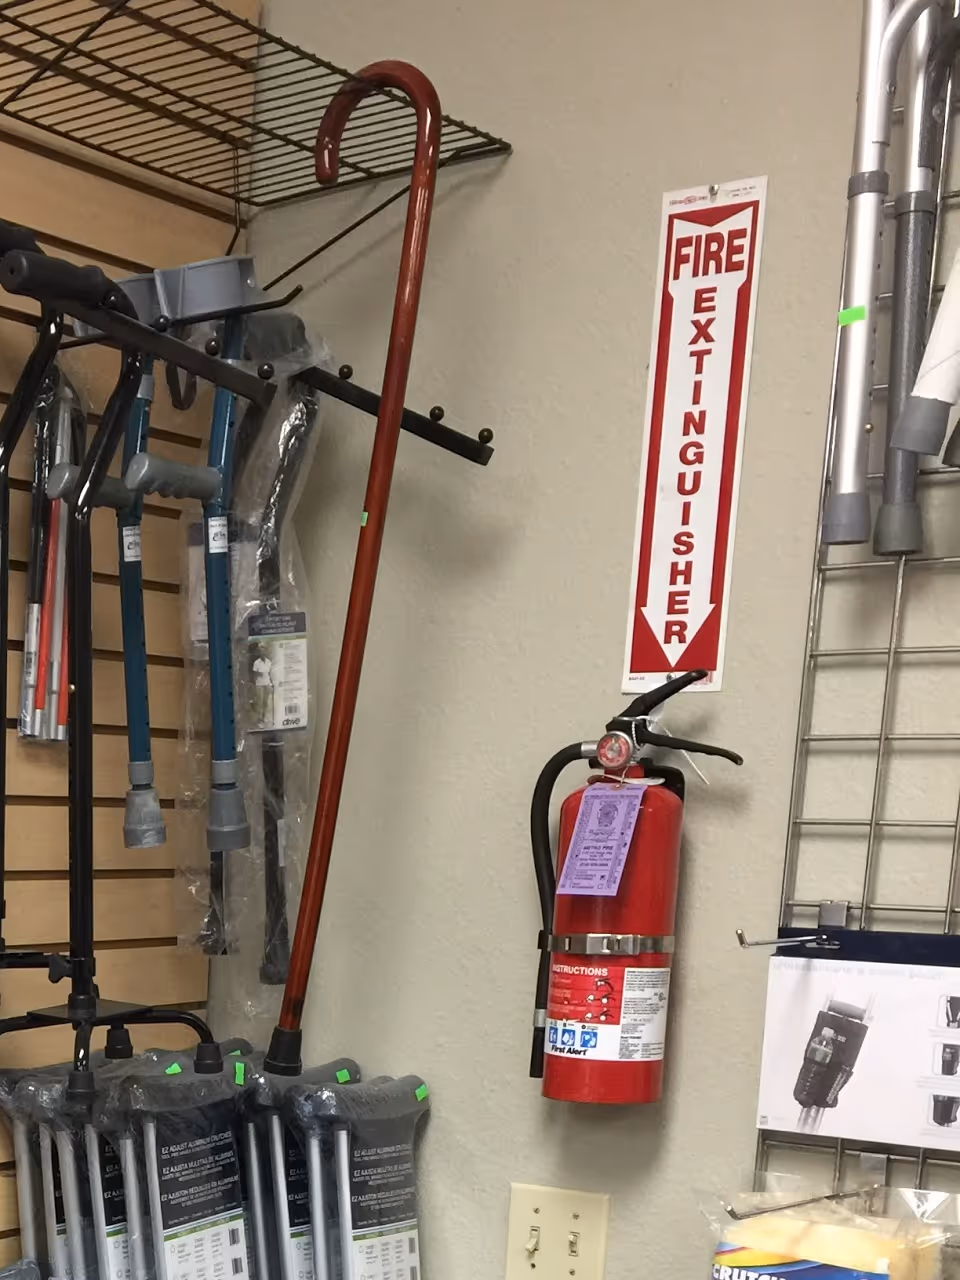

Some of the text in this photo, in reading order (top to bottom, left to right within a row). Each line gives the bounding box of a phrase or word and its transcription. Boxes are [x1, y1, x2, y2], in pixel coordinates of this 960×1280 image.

[673, 228, 747, 281] FIRE
[664, 287, 717, 644] EXTINGUISHER
[551, 1045, 588, 1056] First Alert
